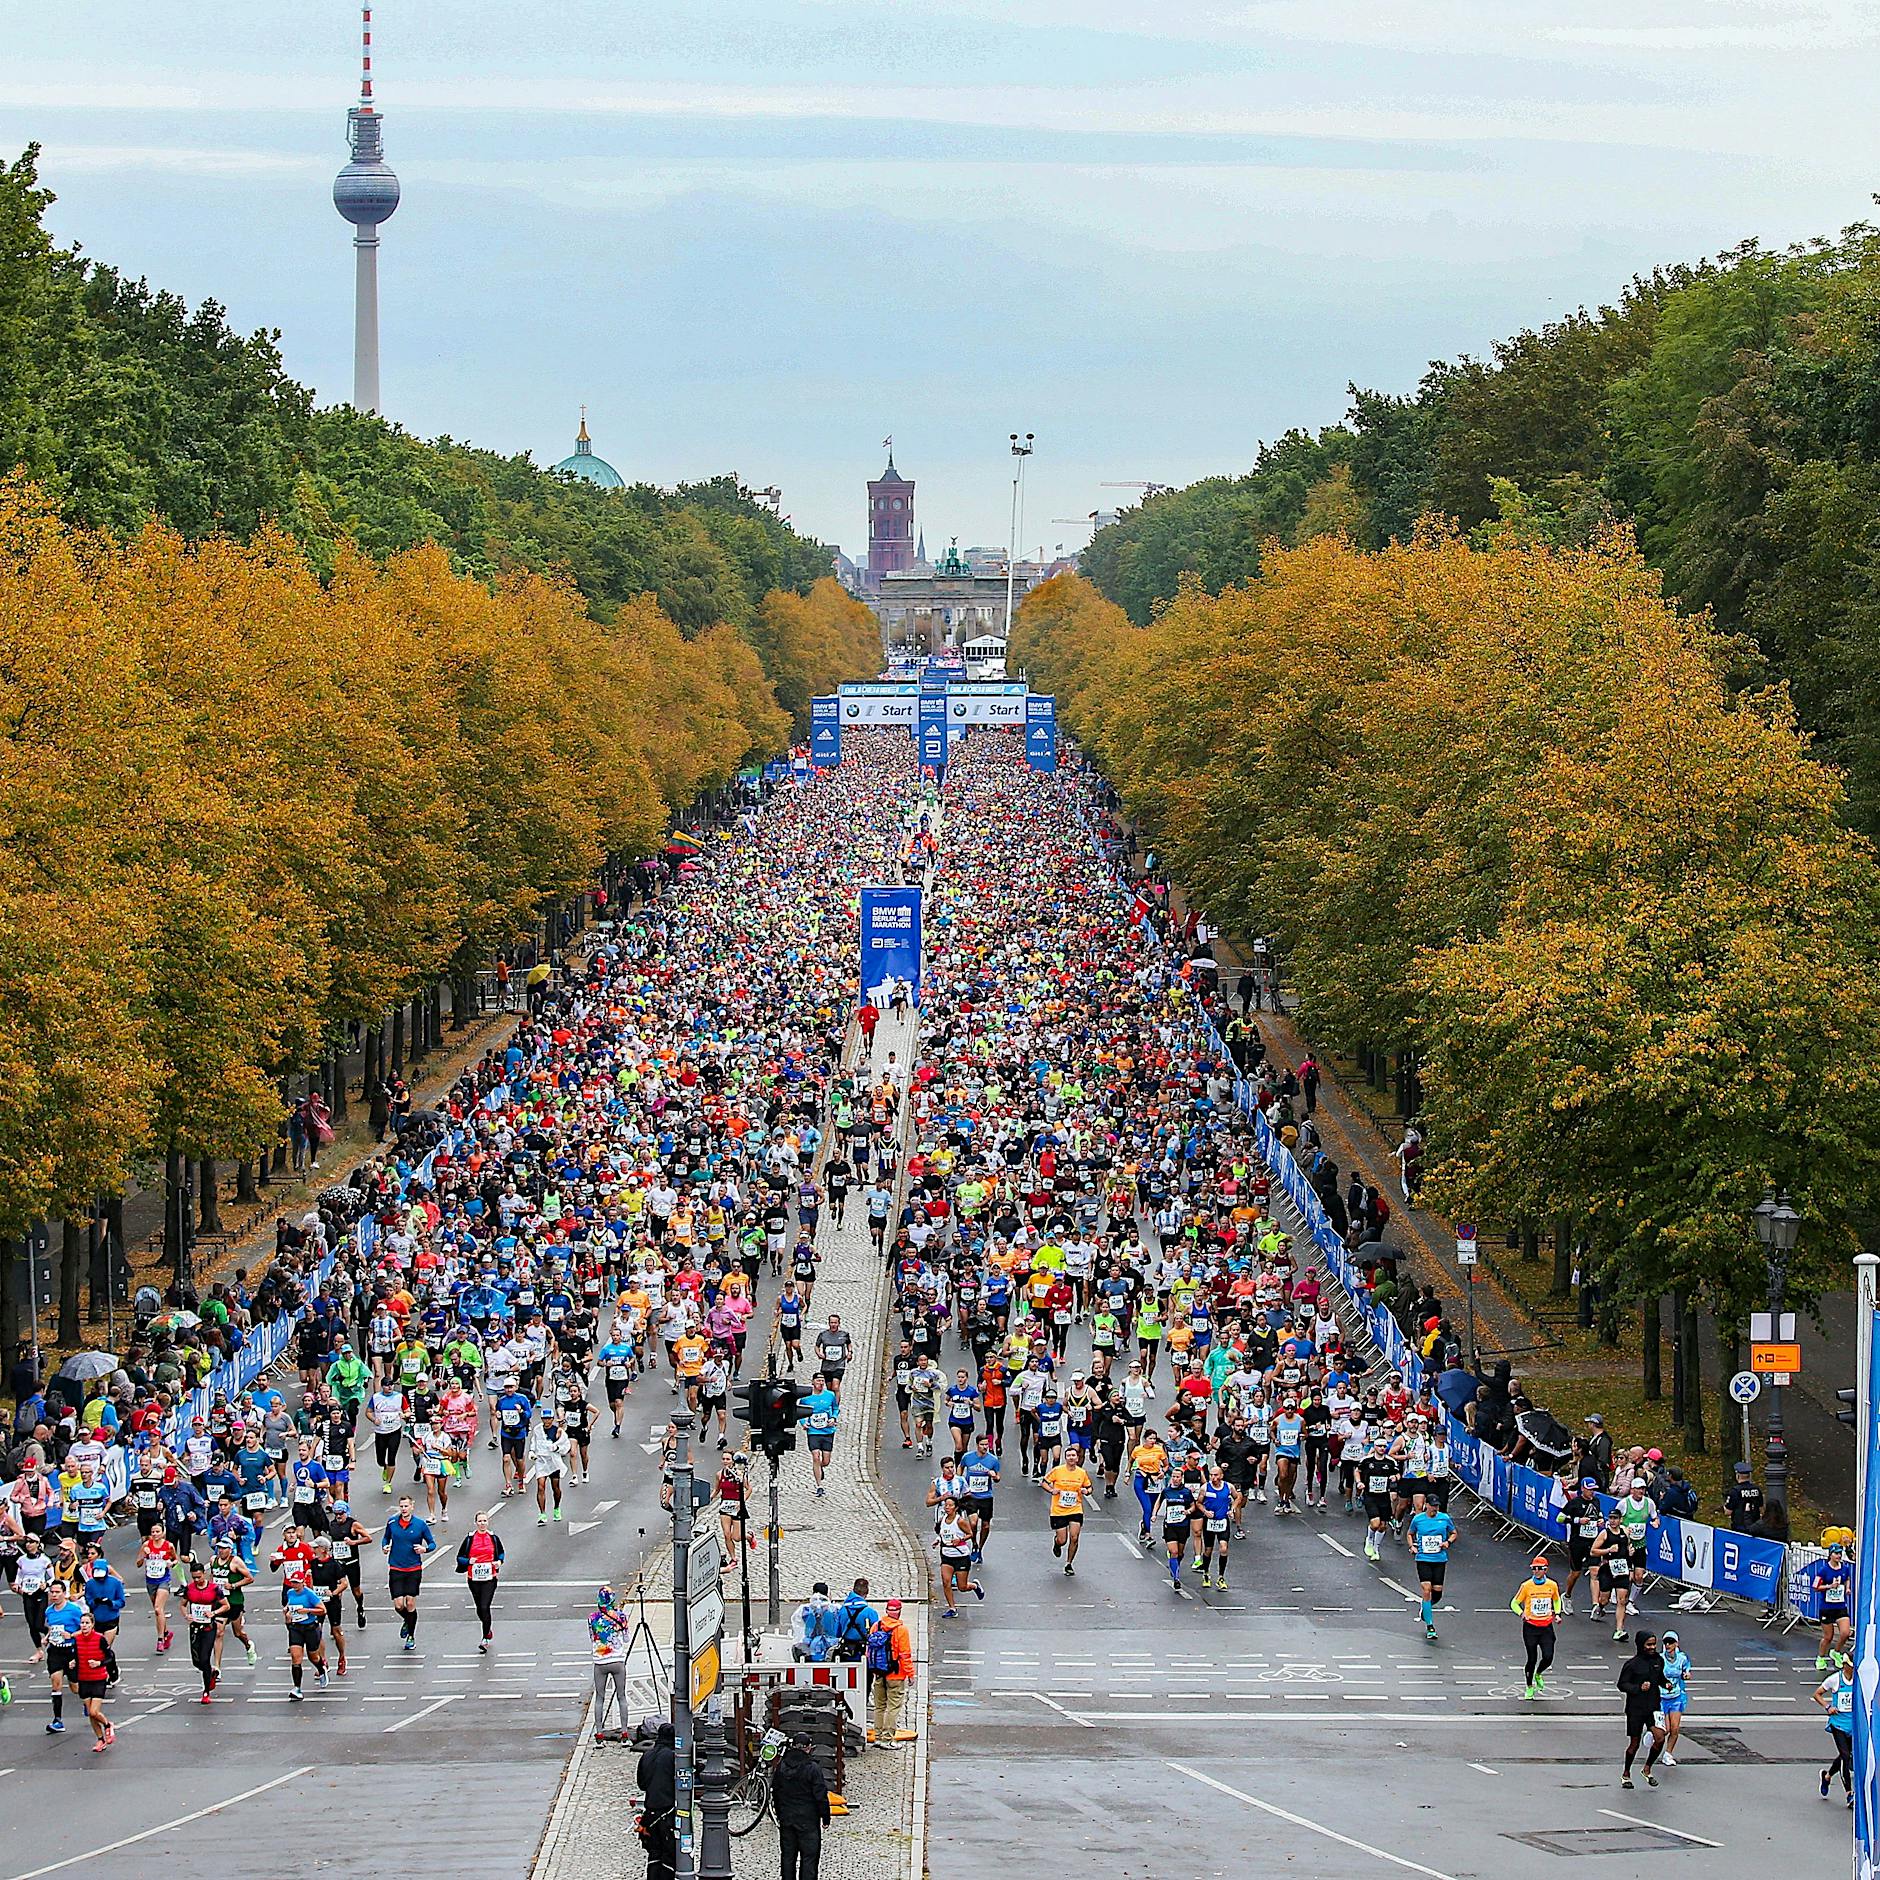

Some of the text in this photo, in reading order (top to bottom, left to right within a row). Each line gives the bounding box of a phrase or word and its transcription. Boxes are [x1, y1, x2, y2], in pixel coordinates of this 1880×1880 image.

[882, 705, 912, 716] Start
[989, 705, 1020, 715] Start
[872, 907, 897, 916] BMW
[1741, 1489, 1760, 1498] POLIZEI
[1660, 1550, 1674, 1562] adidas
